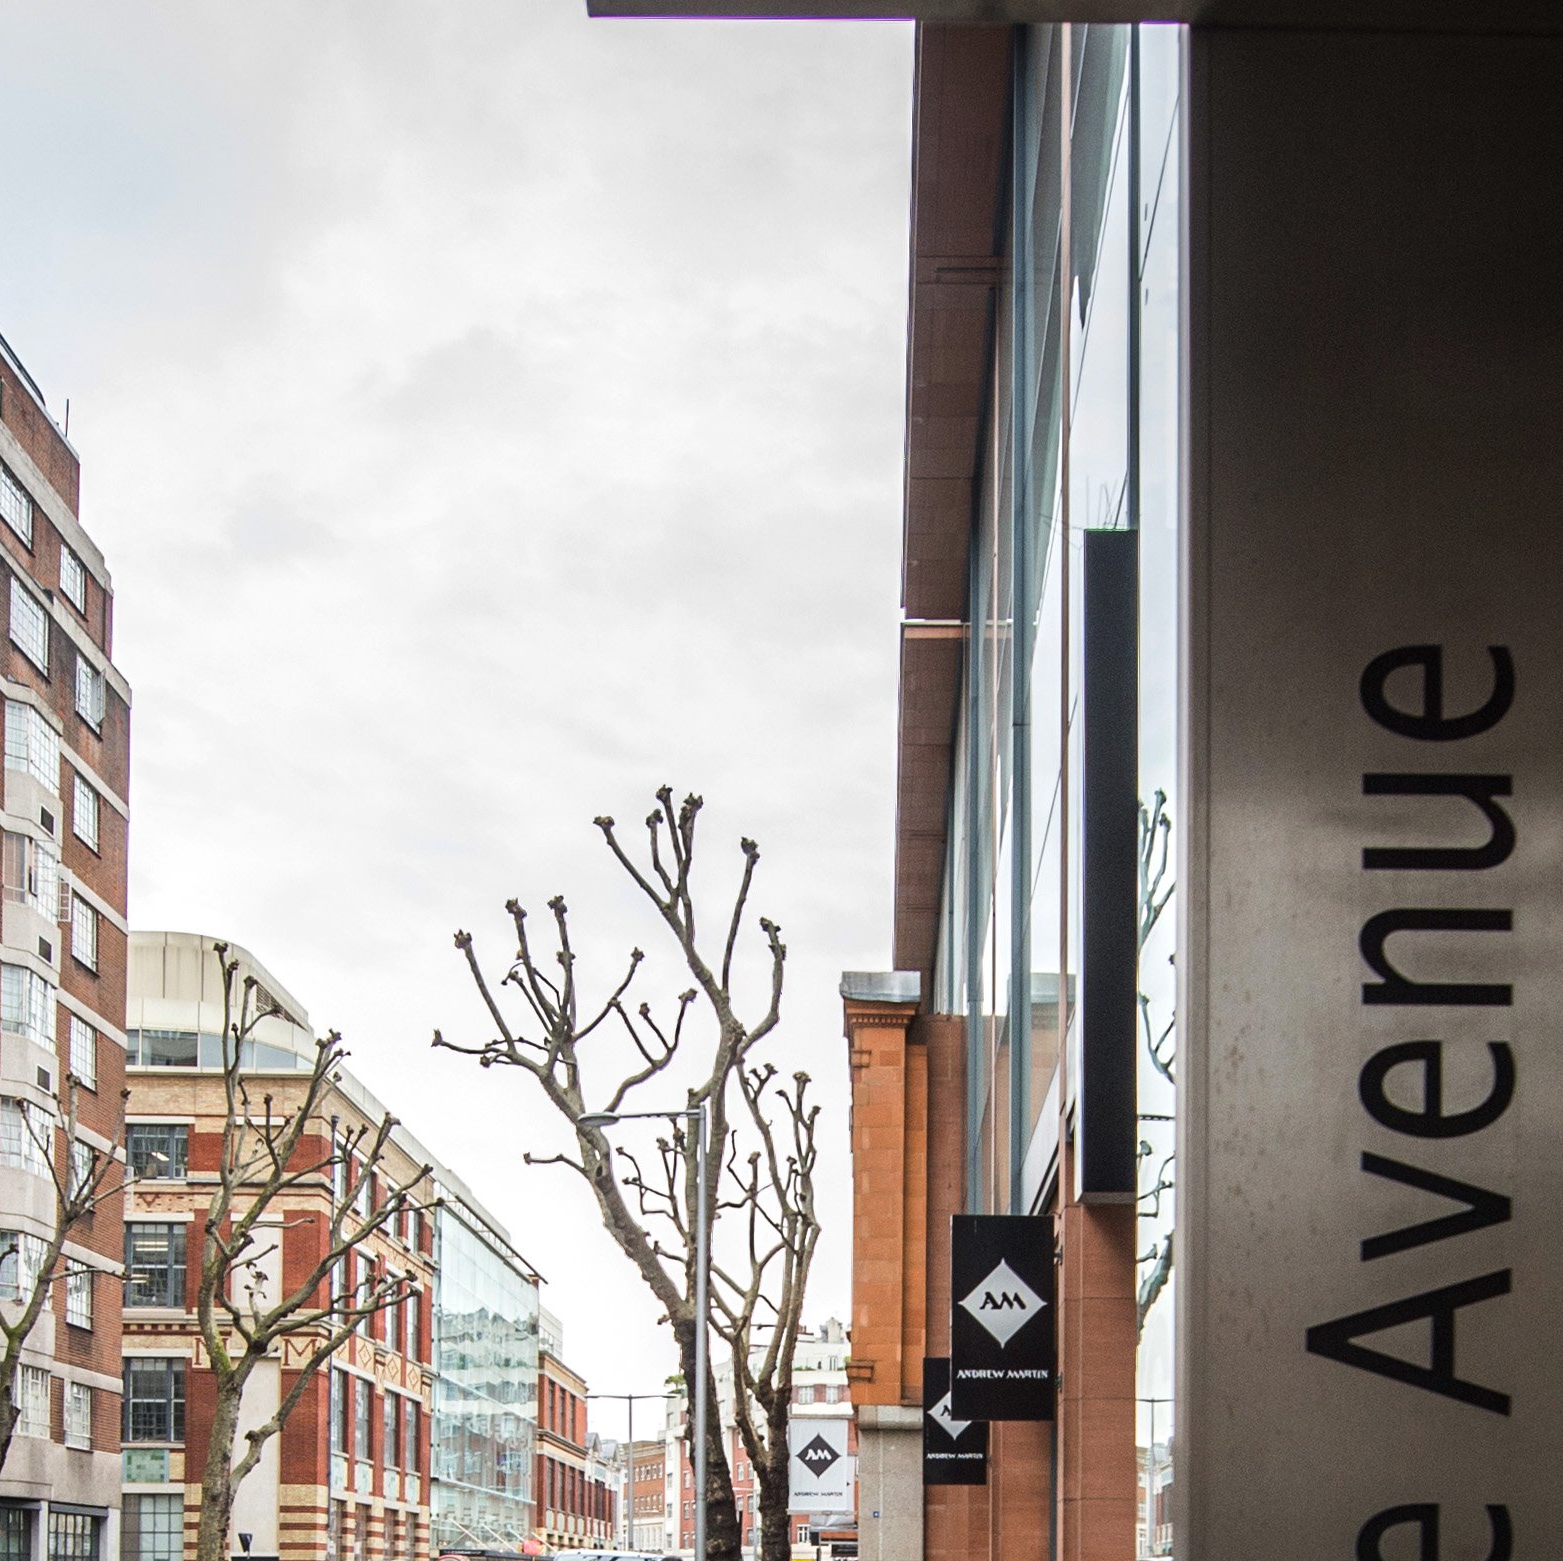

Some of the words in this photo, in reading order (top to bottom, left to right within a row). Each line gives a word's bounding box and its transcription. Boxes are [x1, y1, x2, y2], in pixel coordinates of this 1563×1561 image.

[1304, 643, 1517, 1418] Avenue
[979, 1291, 1027, 1310] AM
[955, 1369, 1005, 1380] ANDREW
[1006, 1369, 1049, 1380] MARTIN
